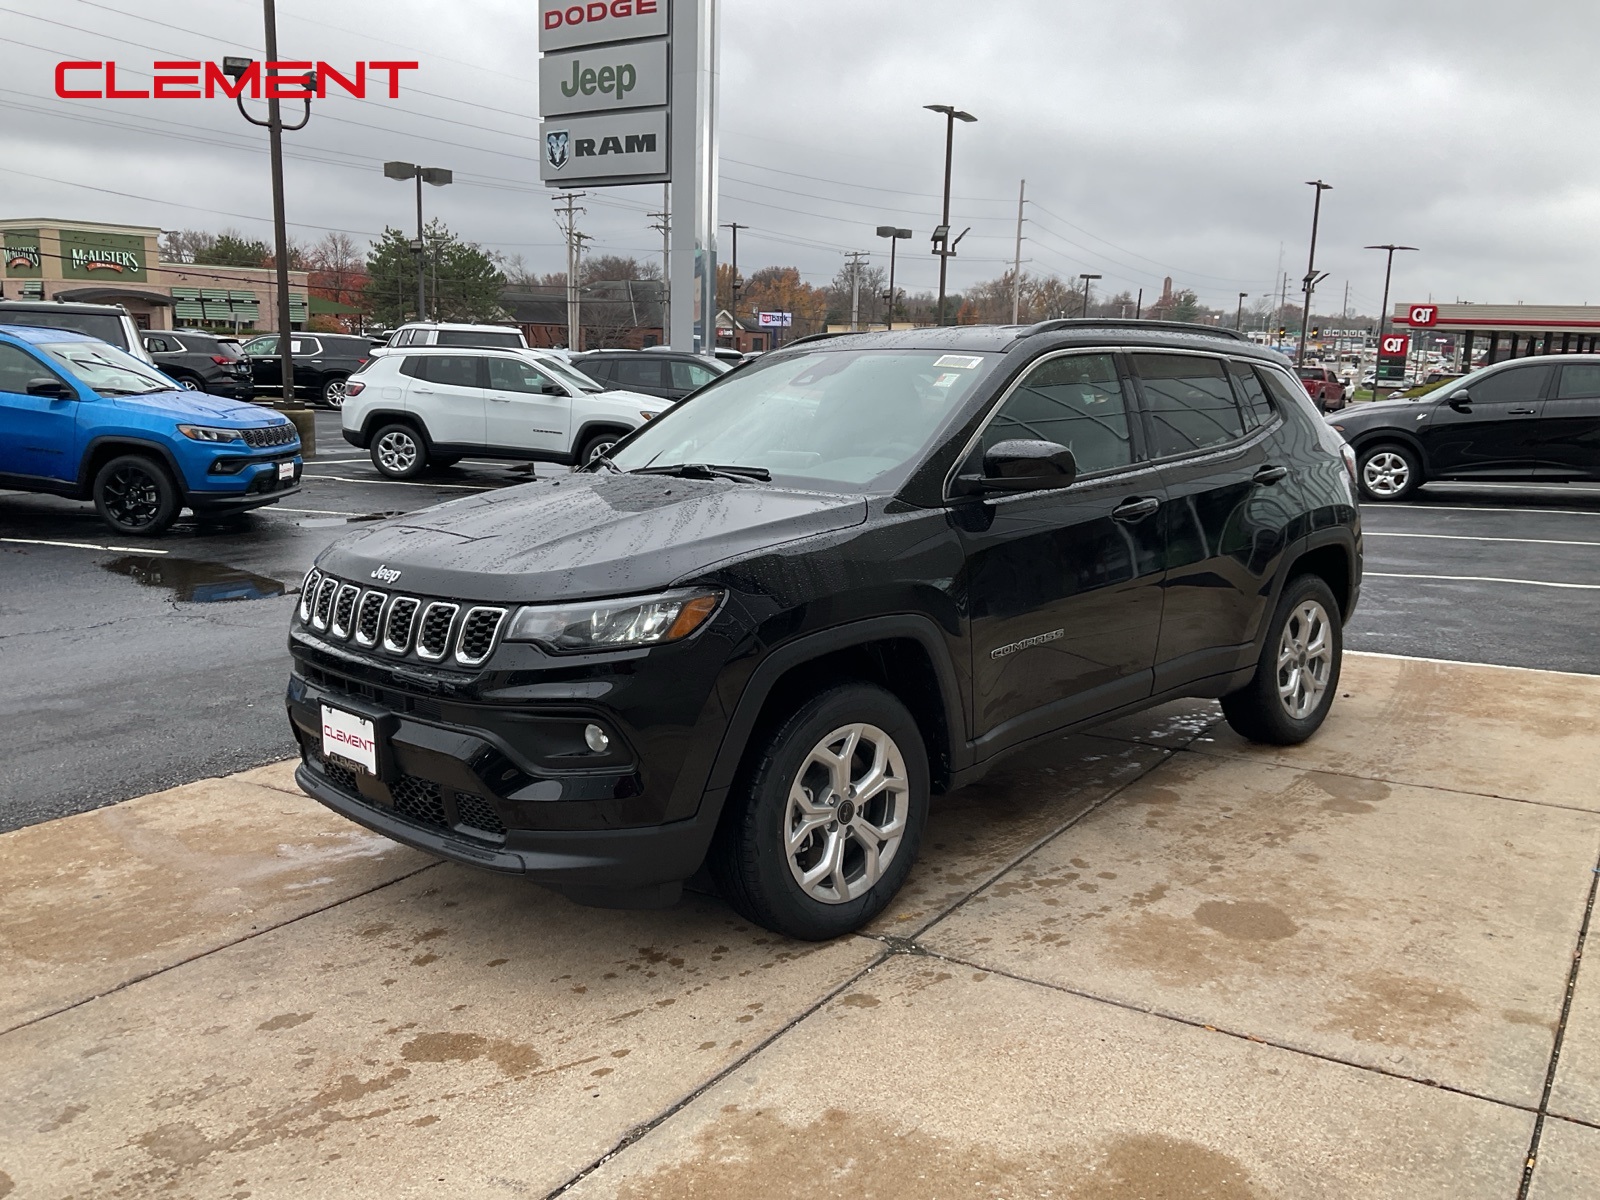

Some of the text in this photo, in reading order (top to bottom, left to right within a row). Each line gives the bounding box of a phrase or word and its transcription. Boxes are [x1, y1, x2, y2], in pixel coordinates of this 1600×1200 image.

[544, 0, 657, 30] DODGE
[561, 60, 636, 100] Jeep
[575, 133, 656, 157] RAM
[1411, 307, 1433, 323] QT
[1383, 337, 1404, 352] QT
[371, 564, 402, 584] Jeep
[991, 628, 1064, 659] COMPASS
[324, 724, 375, 753] CLEMENT
